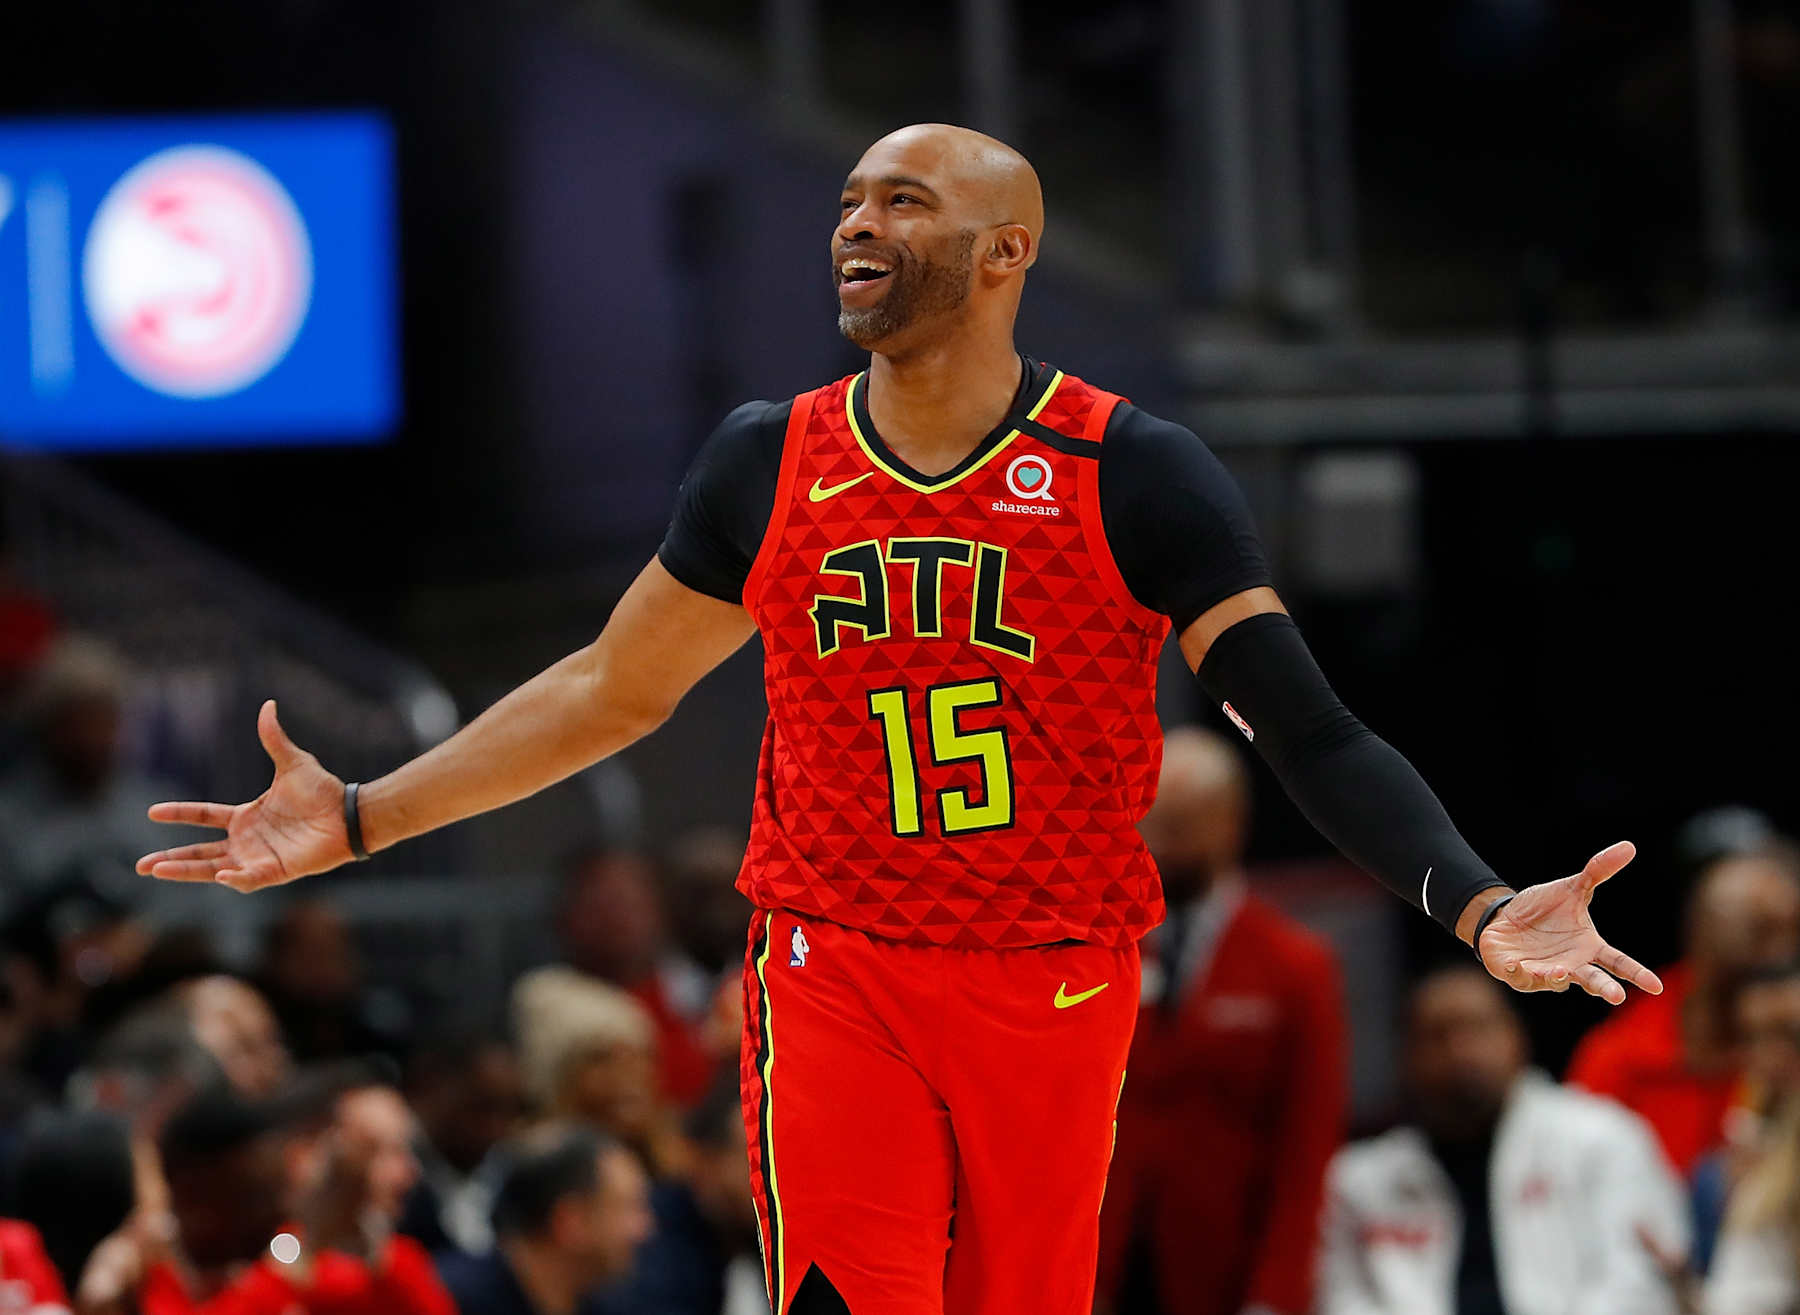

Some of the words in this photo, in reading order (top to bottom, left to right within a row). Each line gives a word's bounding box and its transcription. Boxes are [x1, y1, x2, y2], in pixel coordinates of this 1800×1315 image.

[991, 500, 1060, 517] sharecare
[807, 537, 1037, 663] ATL
[866, 676, 1015, 838] 15
